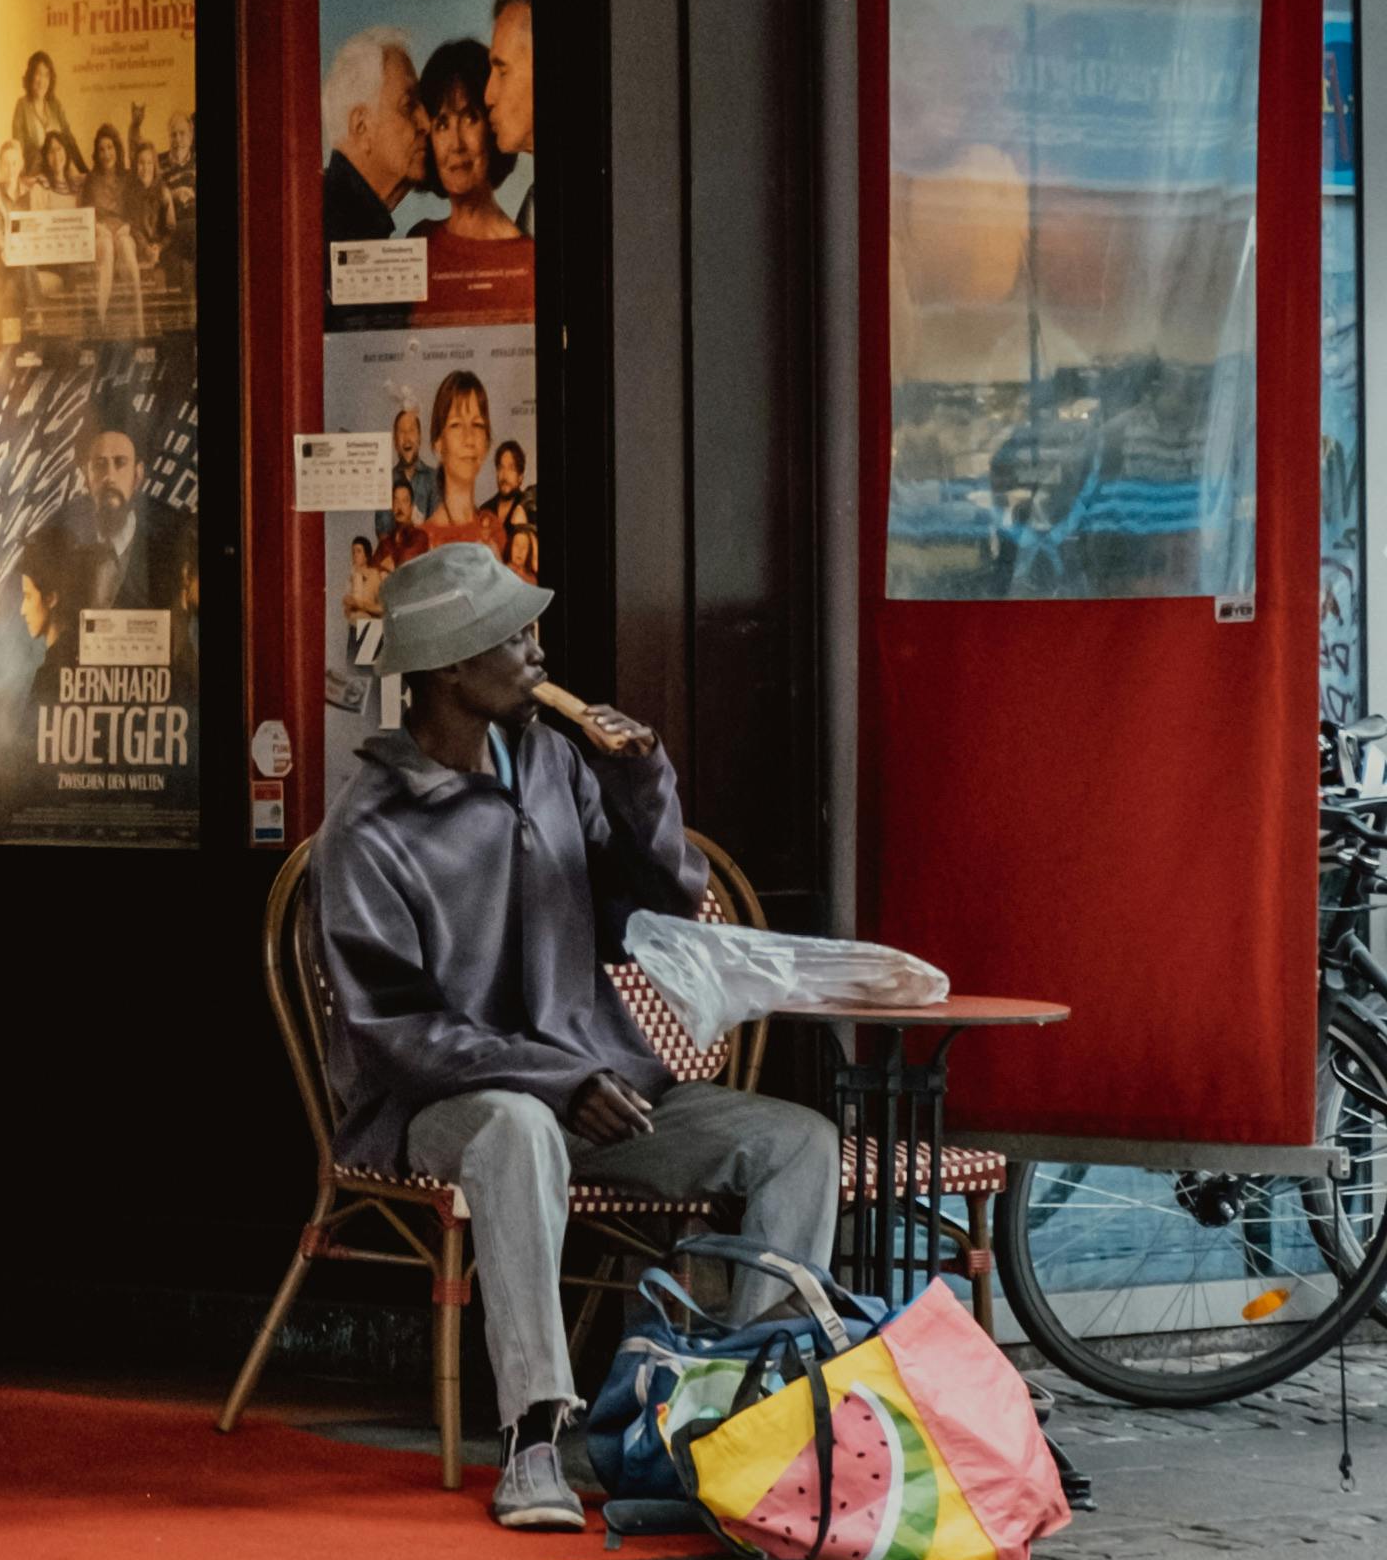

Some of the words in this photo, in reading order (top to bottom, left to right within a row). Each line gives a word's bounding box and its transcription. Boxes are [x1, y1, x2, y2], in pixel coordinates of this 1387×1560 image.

[46, 5, 69, 28] im
[60, 667, 171, 703] BERNHARD
[37, 705, 189, 766] HOETGER
